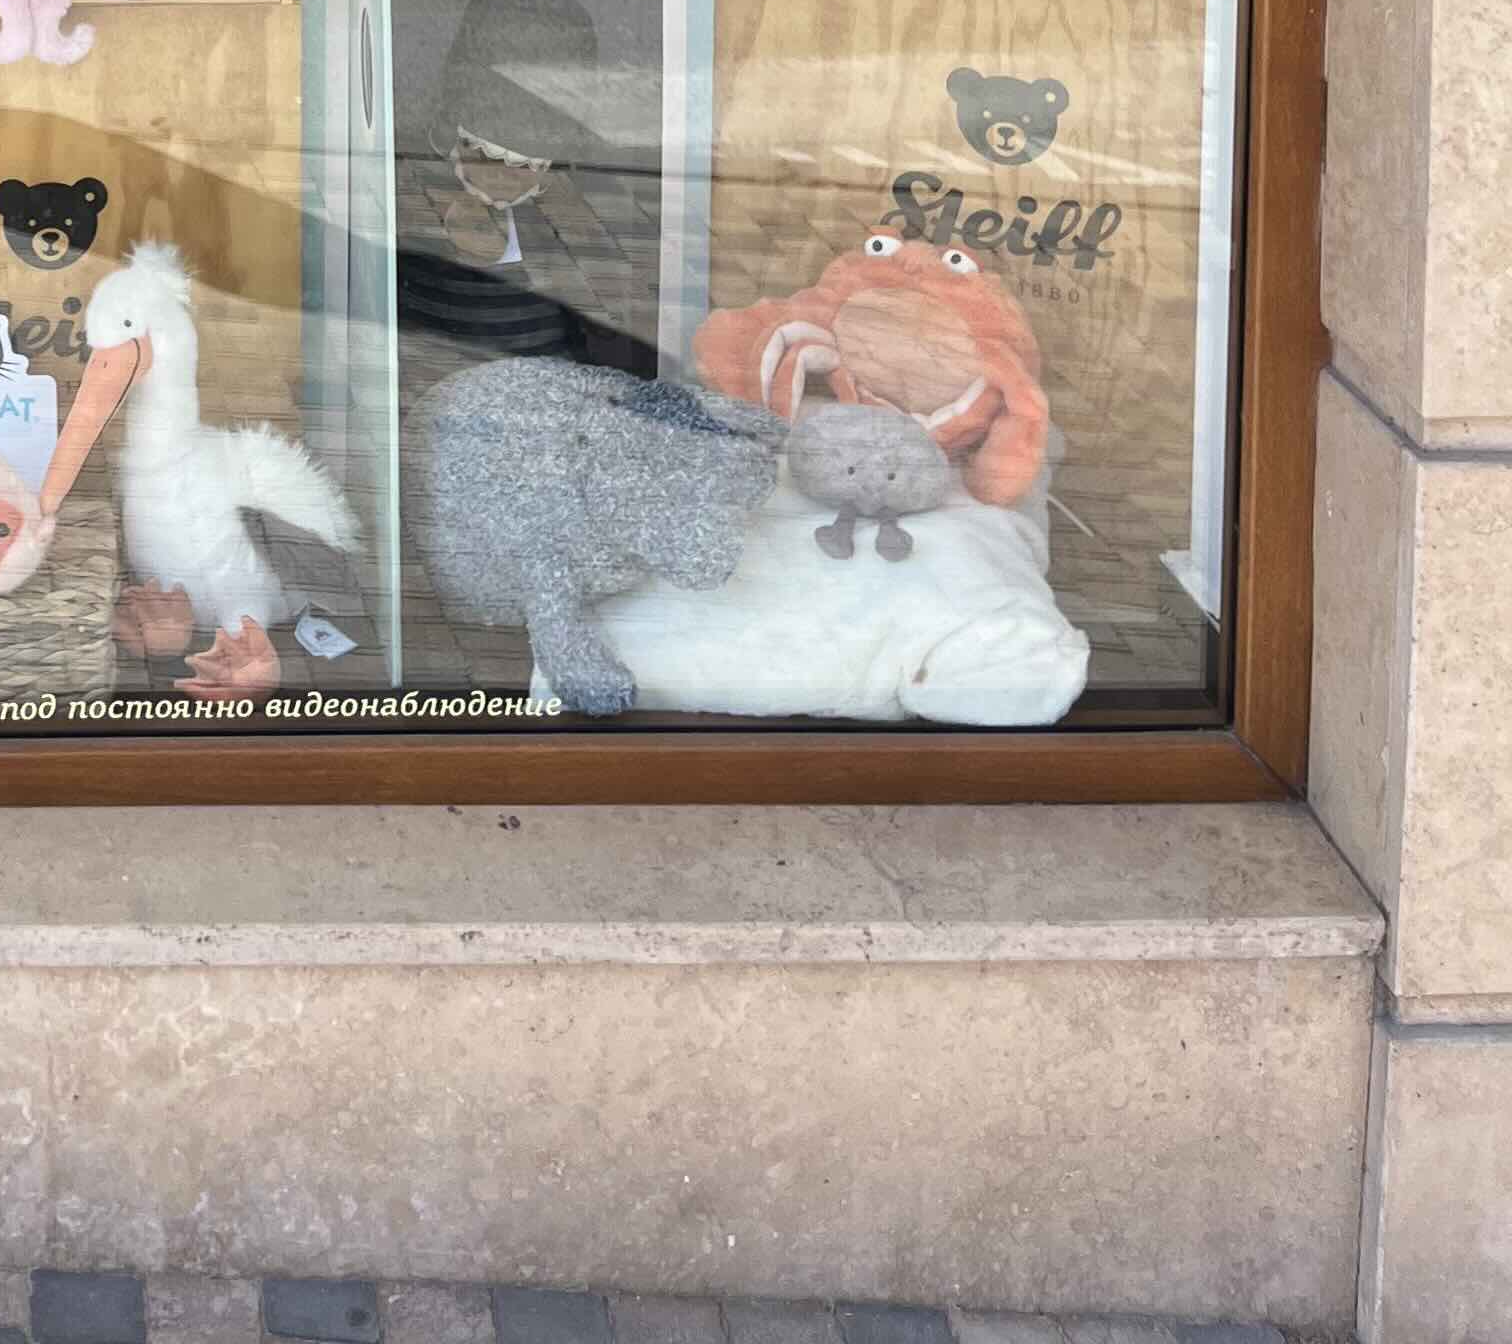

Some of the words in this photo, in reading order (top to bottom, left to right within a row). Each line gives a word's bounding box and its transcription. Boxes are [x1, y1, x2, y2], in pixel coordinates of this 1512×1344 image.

[879, 170, 1123, 271] Steiff
[0, 693, 57, 721] под
[67, 696, 254, 721] постоянно
[264, 690, 562, 719] видеонаблюдение
